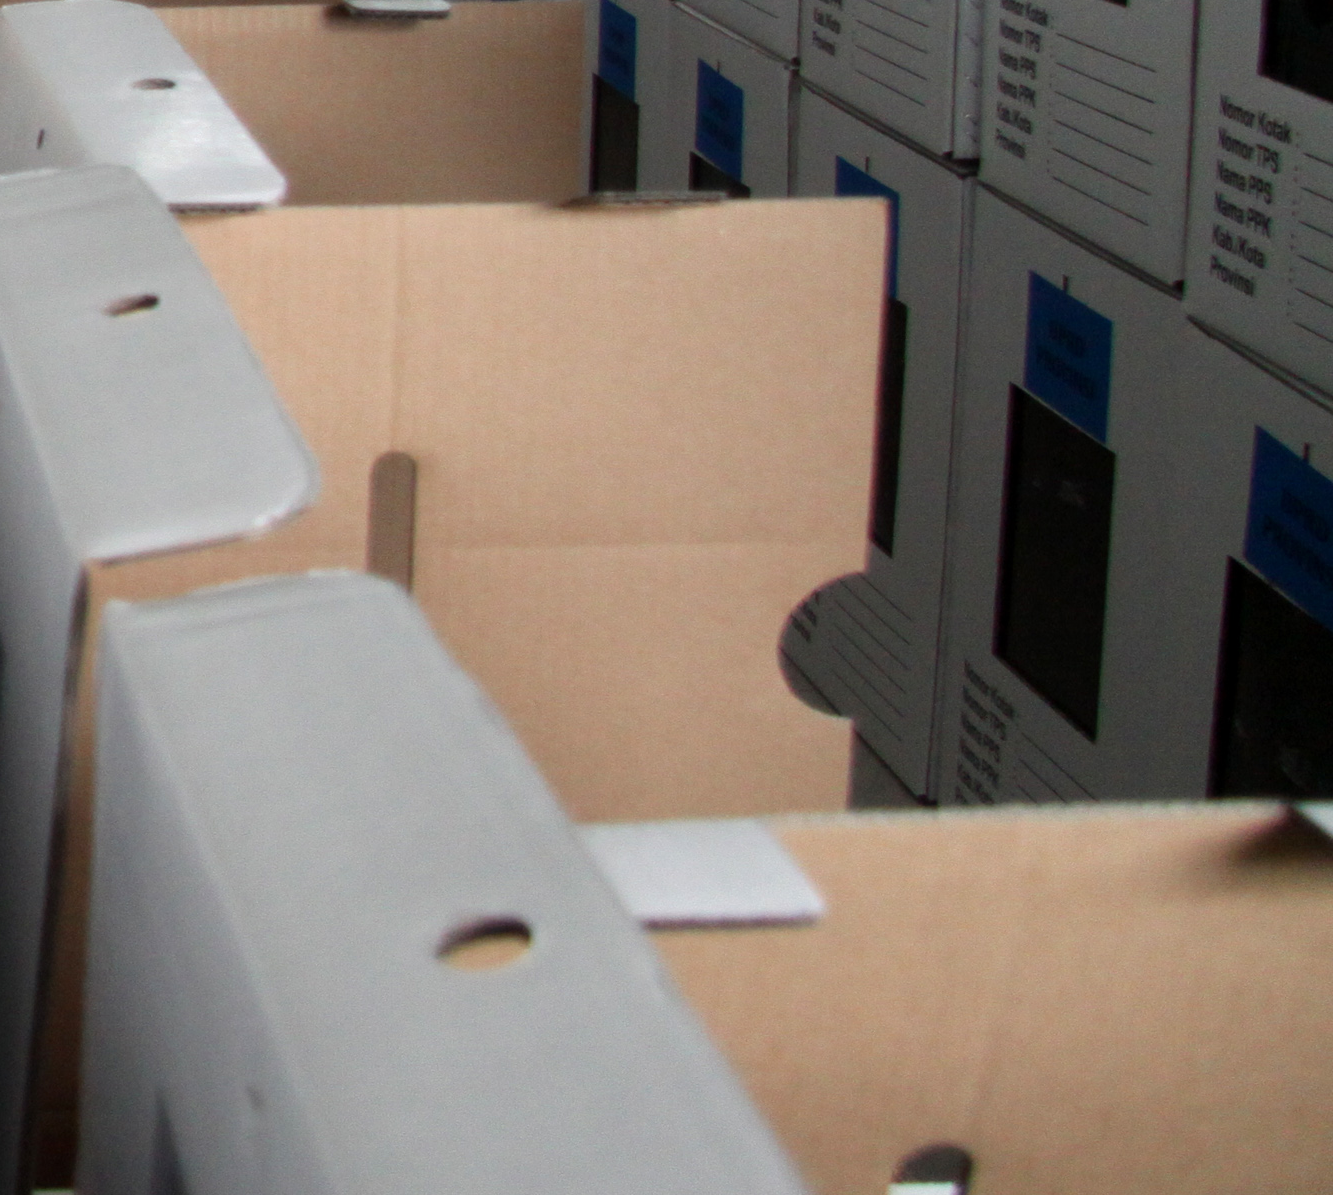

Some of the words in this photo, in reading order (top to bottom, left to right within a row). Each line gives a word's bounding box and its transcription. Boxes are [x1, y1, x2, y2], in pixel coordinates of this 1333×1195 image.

[1219, 94, 1255, 129] Nomor
[1257, 112, 1291, 145] Kotak
[1218, 126, 1253, 161] Nomor
[1256, 144, 1279, 174] TPS
[1217, 158, 1246, 192] Nama
[1248, 175, 1273, 205] PPS
[1215, 191, 1245, 225] Nama
[1246, 208, 1271, 238] PPK
[1210, 254, 1255, 297] Provinsi
